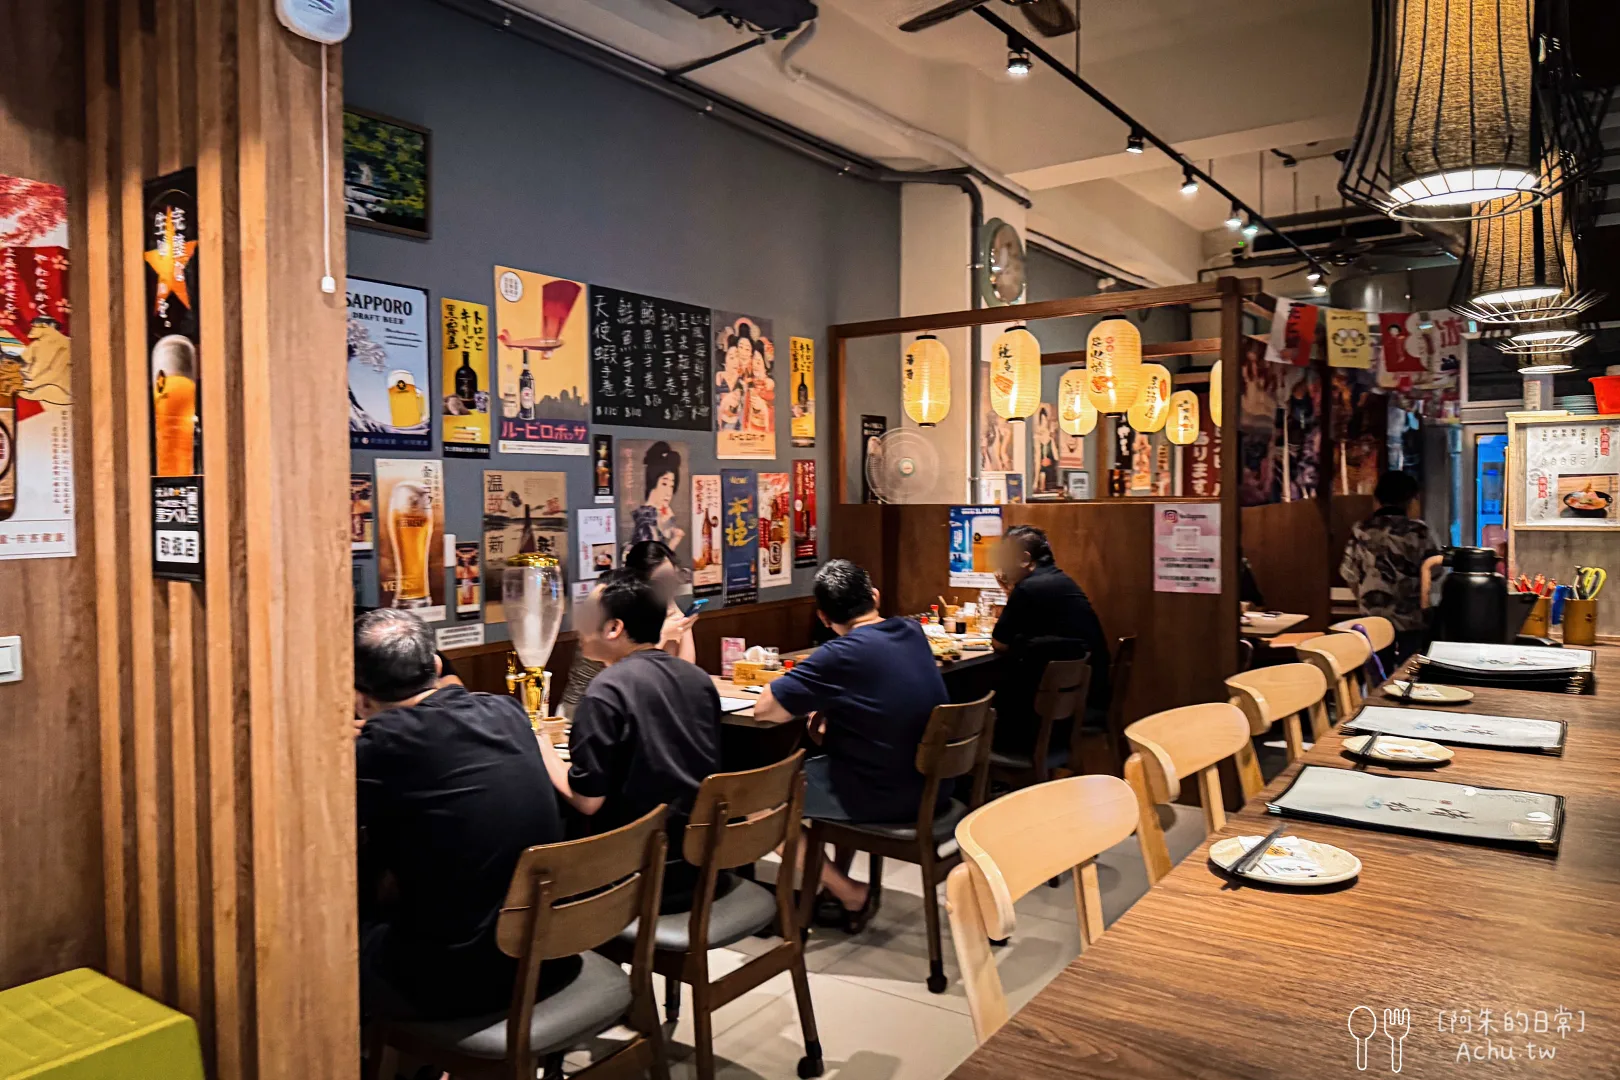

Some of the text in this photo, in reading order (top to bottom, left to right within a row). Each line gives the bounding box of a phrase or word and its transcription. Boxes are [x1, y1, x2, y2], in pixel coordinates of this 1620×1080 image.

[346, 290, 413, 317] SAPPORO
[352, 312, 405, 326] DRAFT BEER
